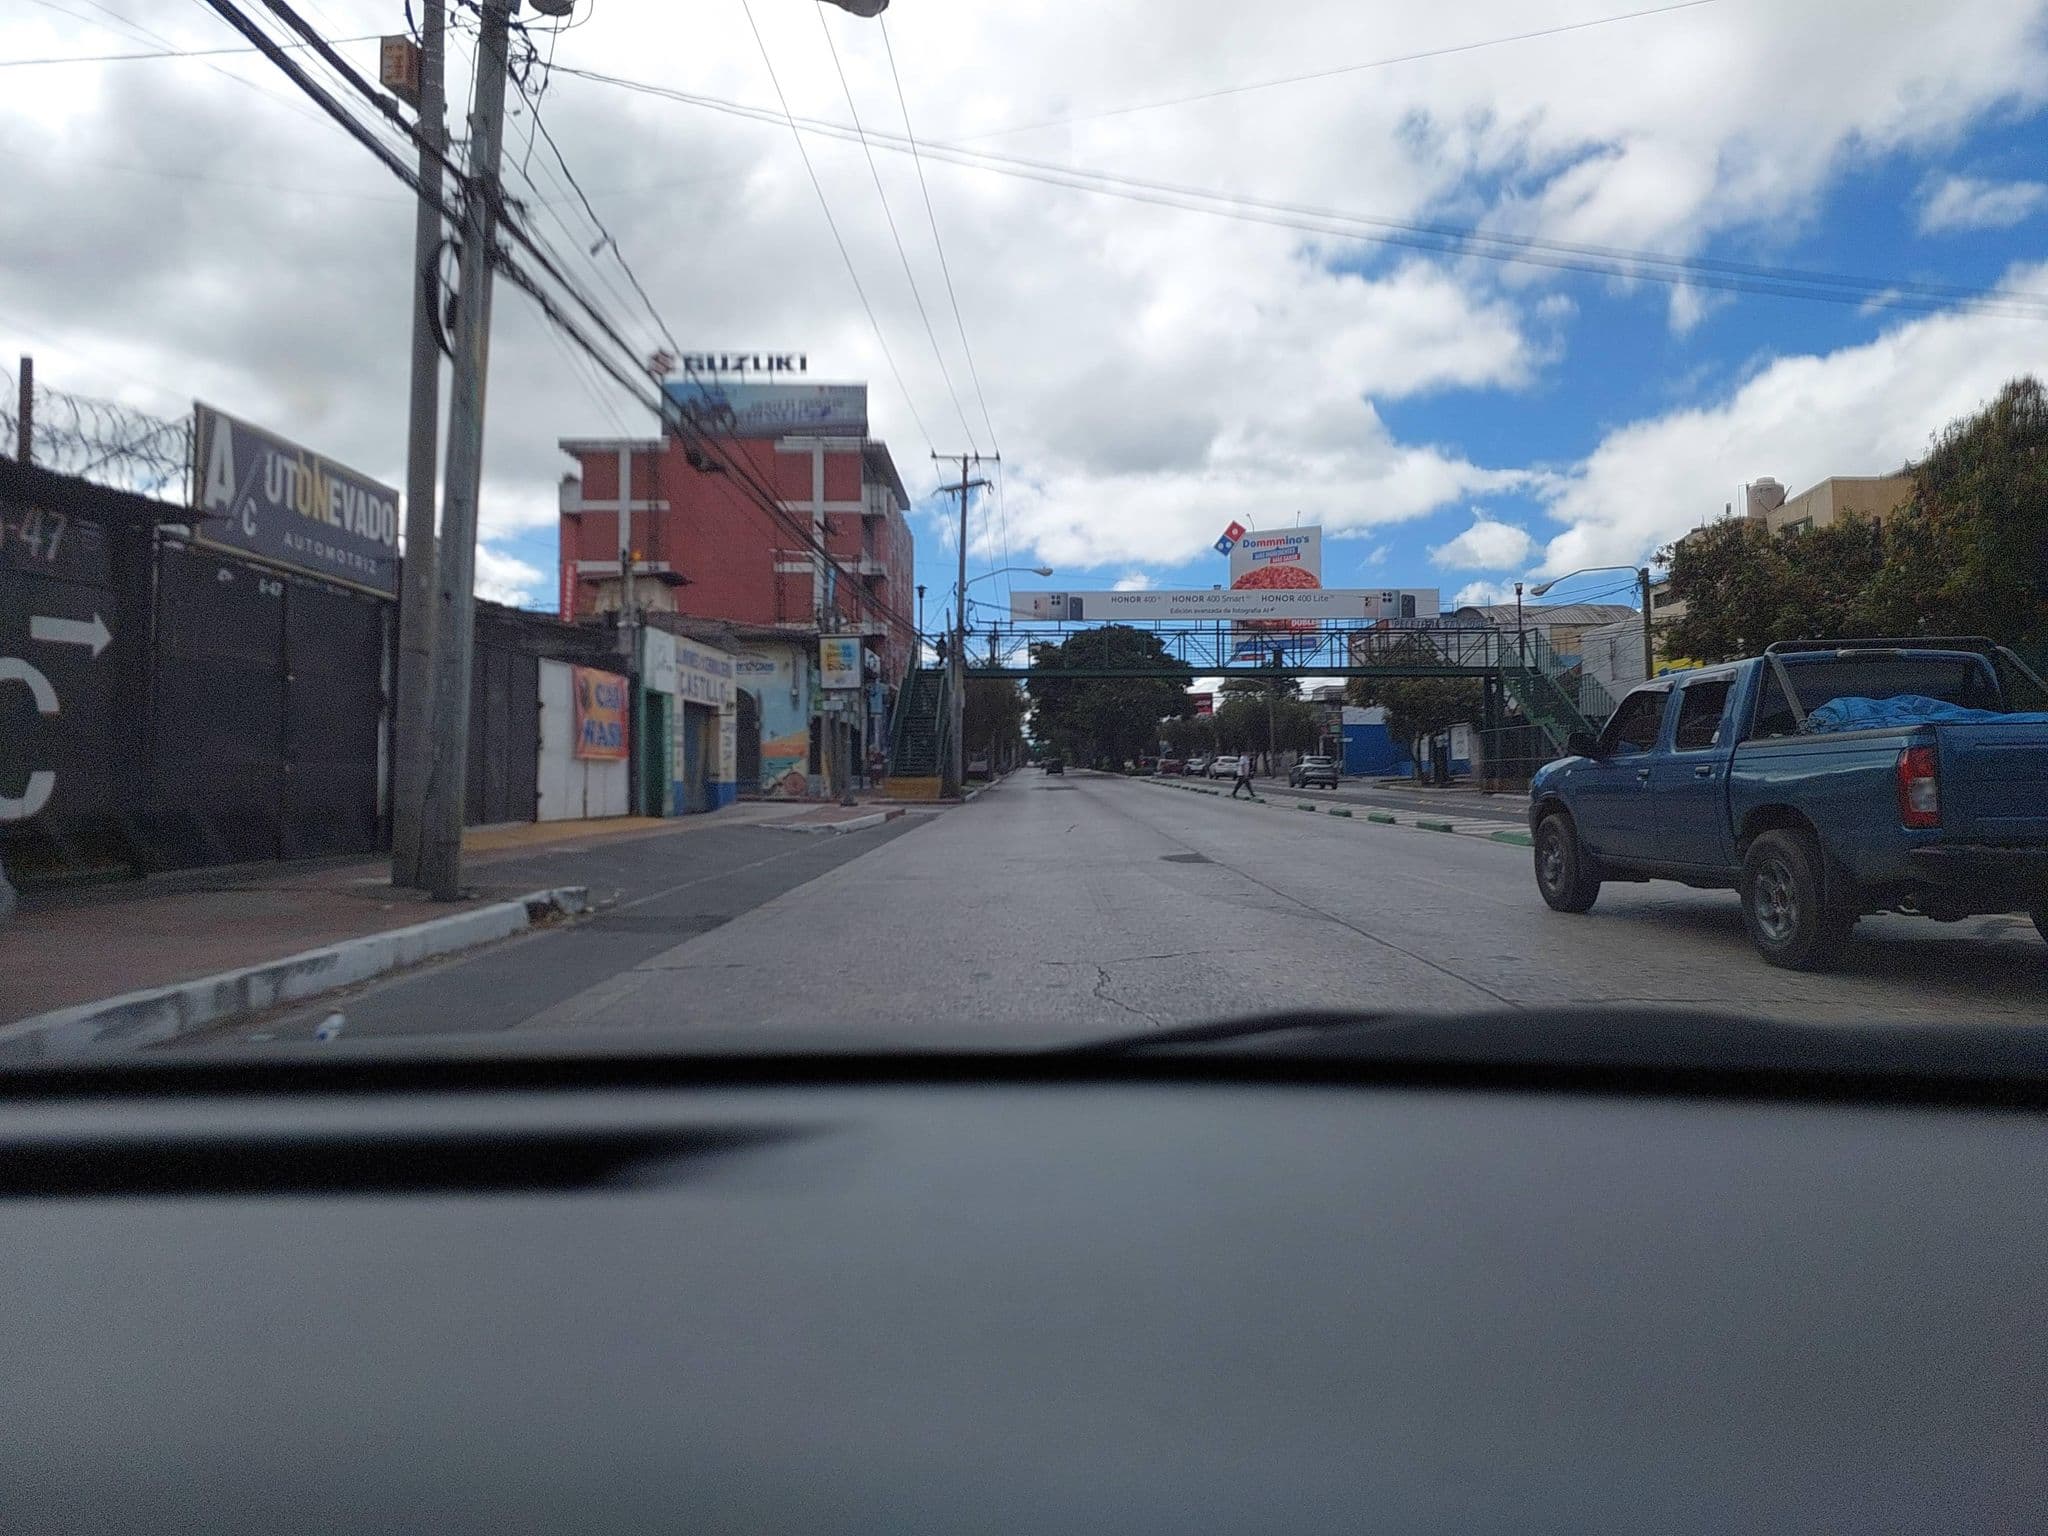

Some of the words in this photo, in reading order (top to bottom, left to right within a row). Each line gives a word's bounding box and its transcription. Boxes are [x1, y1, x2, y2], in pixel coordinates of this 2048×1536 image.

[683, 353, 807, 372] SUZUKI
[1242, 535, 1309, 549] Dommmino's
[284, 532, 378, 574] AUTOMOTRIZ
[1111, 596, 1142, 604] HONOR
[1171, 595, 1205, 603] HONOR
[1206, 595, 1221, 603] 400
[1222, 595, 1245, 603] Smart
[1261, 594, 1295, 602] HONOR
[1297, 594, 1312, 602] 400
[1314, 594, 1329, 602] Lite
